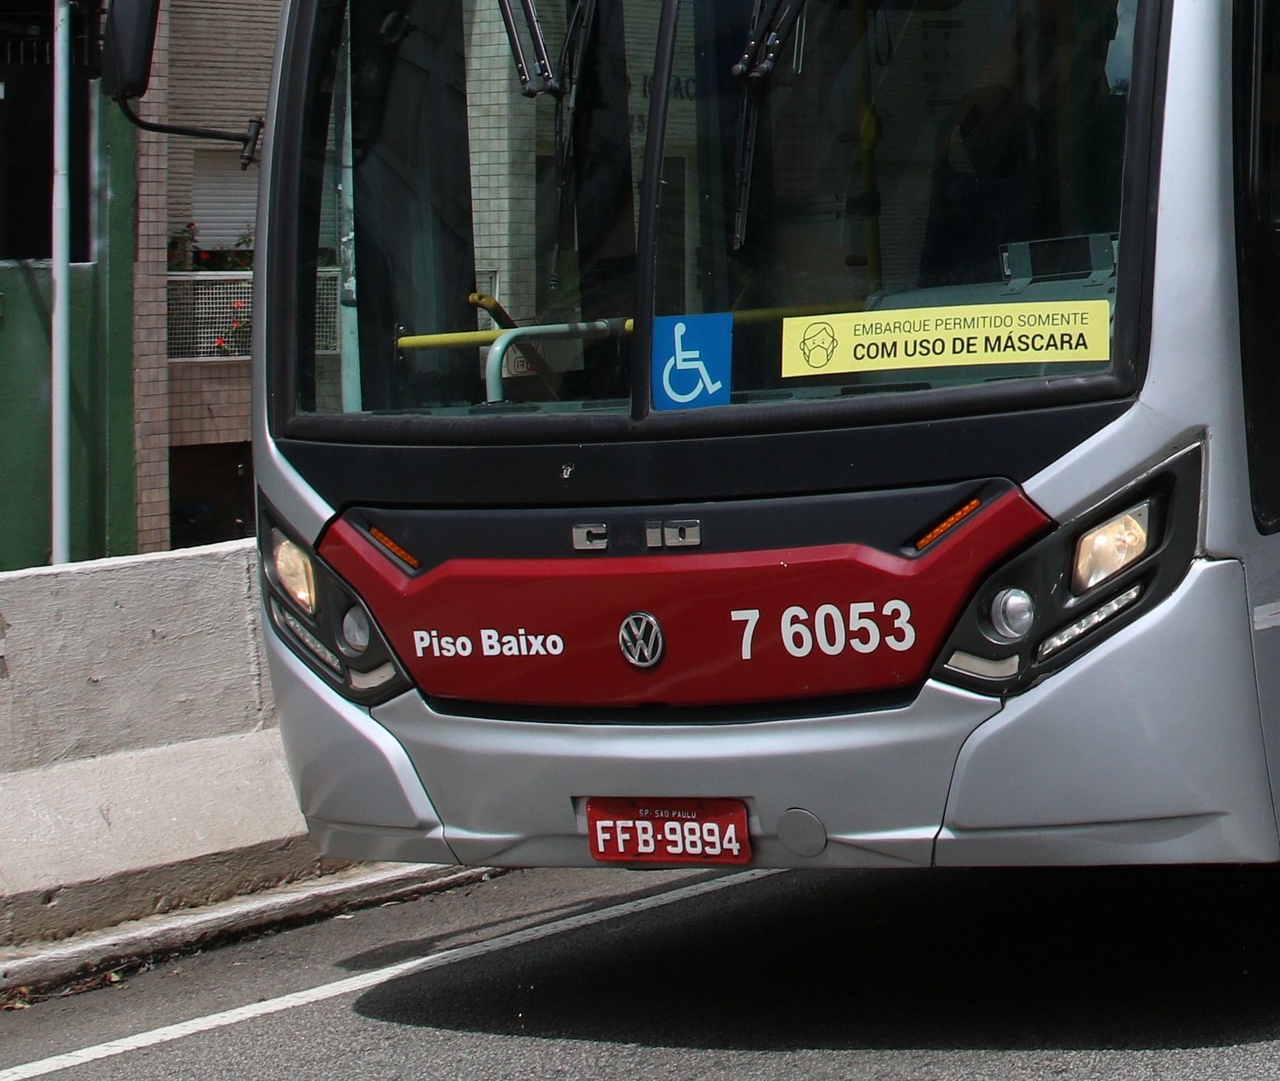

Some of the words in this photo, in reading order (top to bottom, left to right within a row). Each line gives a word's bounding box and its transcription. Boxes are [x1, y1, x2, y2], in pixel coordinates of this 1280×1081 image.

[853, 318, 930, 337] EMBARQUE
[935, 314, 1013, 332] PERMITIDO
[1017, 312, 1089, 328] SOMENTE
[853, 340, 898, 361] COM
[903, 337, 945, 358] USO
[951, 335, 978, 355] DE
[983, 330, 1089, 354] MÁSCARA
[413, 630, 473, 658] Piso
[481, 627, 565, 657] Baixo
[730, 608, 761, 660] 7
[780, 598, 917, 658] 6053
